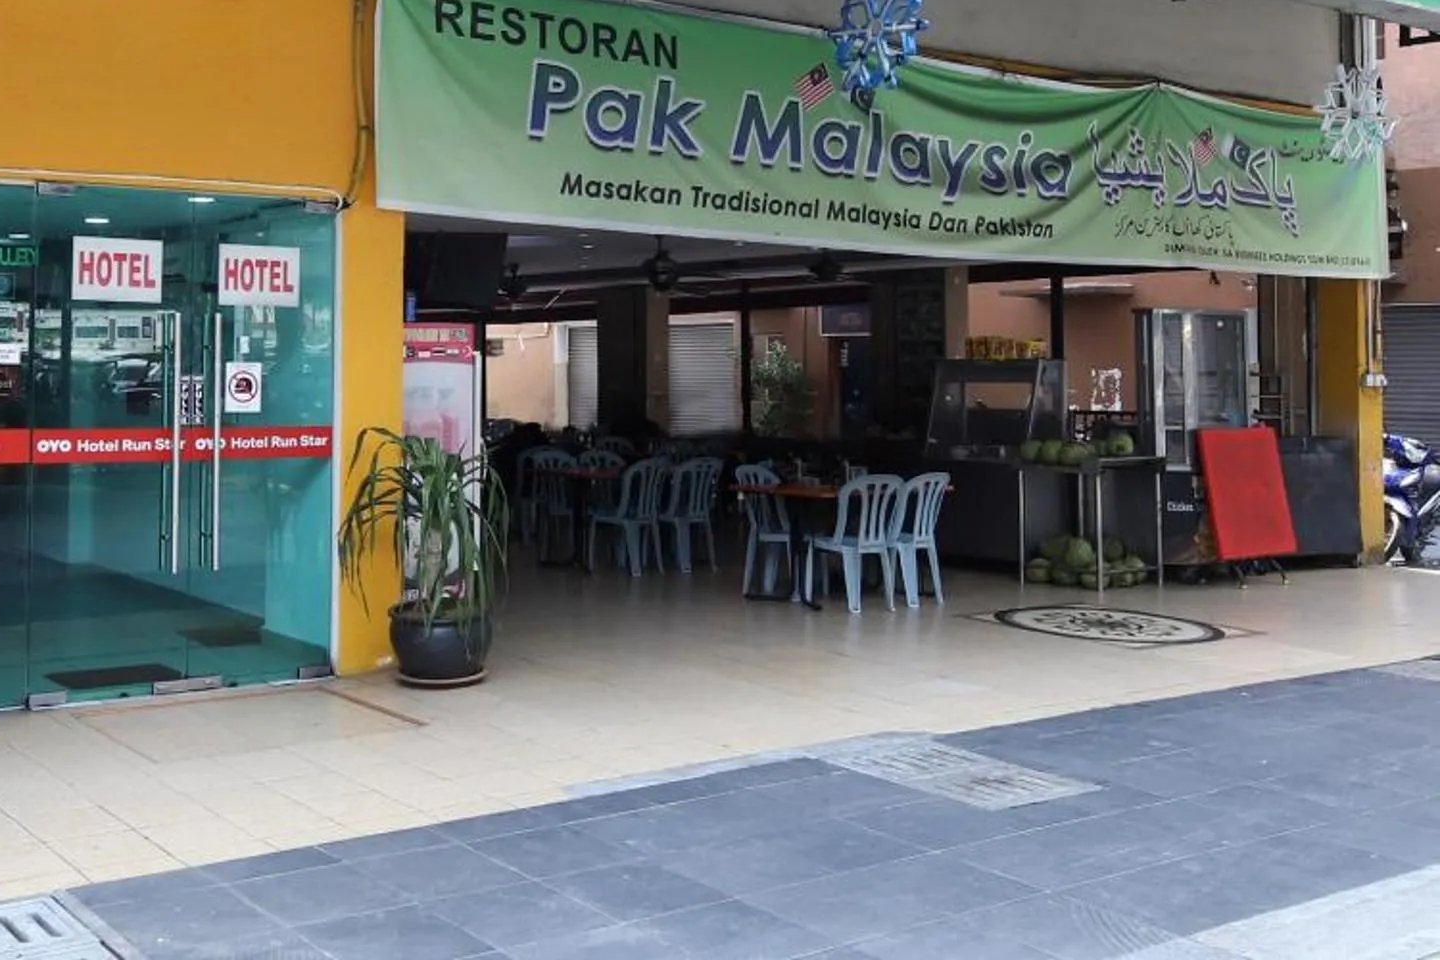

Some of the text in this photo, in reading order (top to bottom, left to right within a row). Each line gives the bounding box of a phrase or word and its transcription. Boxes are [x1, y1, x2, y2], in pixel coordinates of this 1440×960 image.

[526, 58, 1077, 206] Pak Malaysia
[560, 171, 1054, 239] Masakan Tradisional Malaysia Dan Pakistan
[78, 250, 156, 289] HOTEL
[224, 257, 294, 293] HOTEL
[36, 437, 187, 453] OYO Hotel Run Str
[231, 436, 268, 450] Hotel
[271, 435, 297, 449] Run
[300, 434, 328, 448] Star
